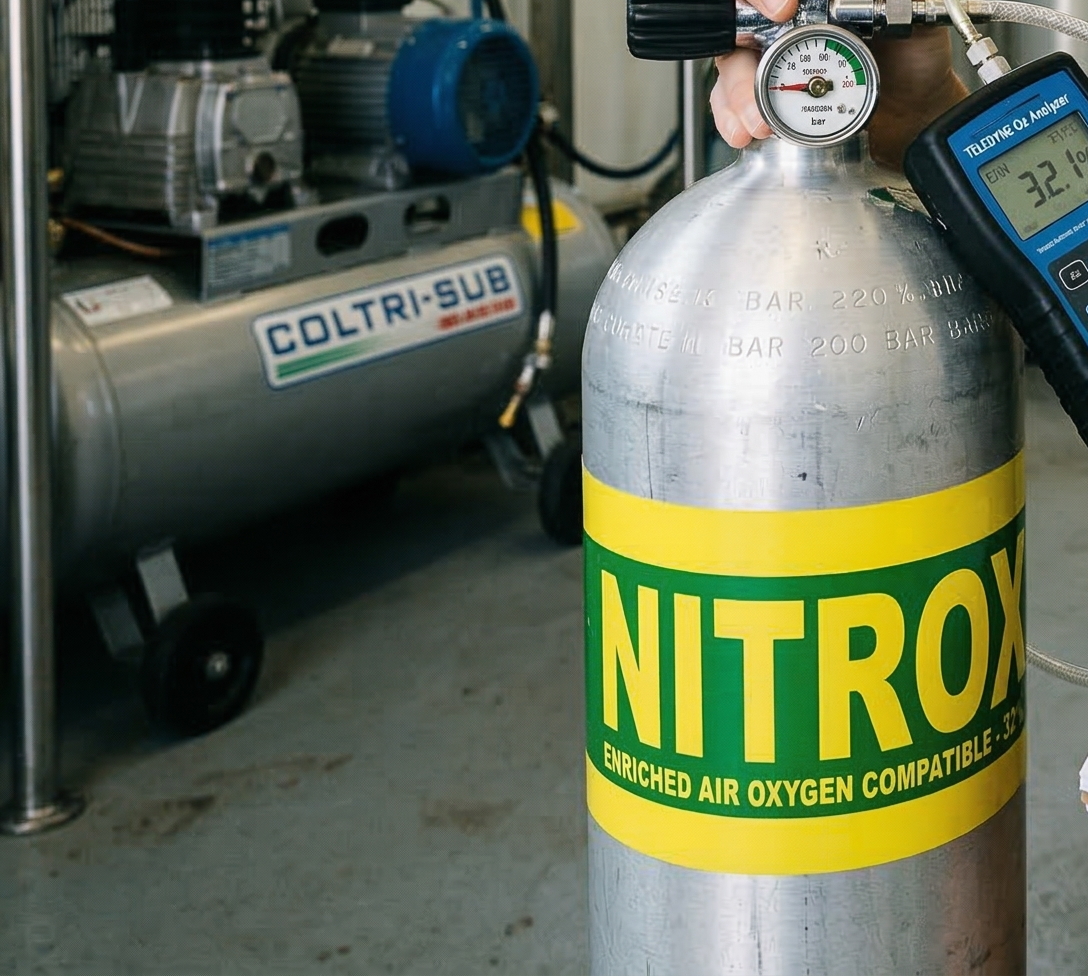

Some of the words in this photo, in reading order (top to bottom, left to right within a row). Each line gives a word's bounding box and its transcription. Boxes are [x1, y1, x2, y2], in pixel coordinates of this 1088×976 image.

[963, 124, 1014, 158] TELEDYNE
[266, 264, 511, 356] COLTRI-SUB
[728, 335, 784, 359] BAR
[811, 333, 868, 358] 200
[885, 325, 935, 351] BAR
[602, 527, 1026, 764] NITROX
[604, 740, 691, 800] ENRICHED
[698, 777, 739, 806] AIR
[747, 775, 853, 808] OXYGEN
[862, 727, 992, 799] COMPATIBLE
